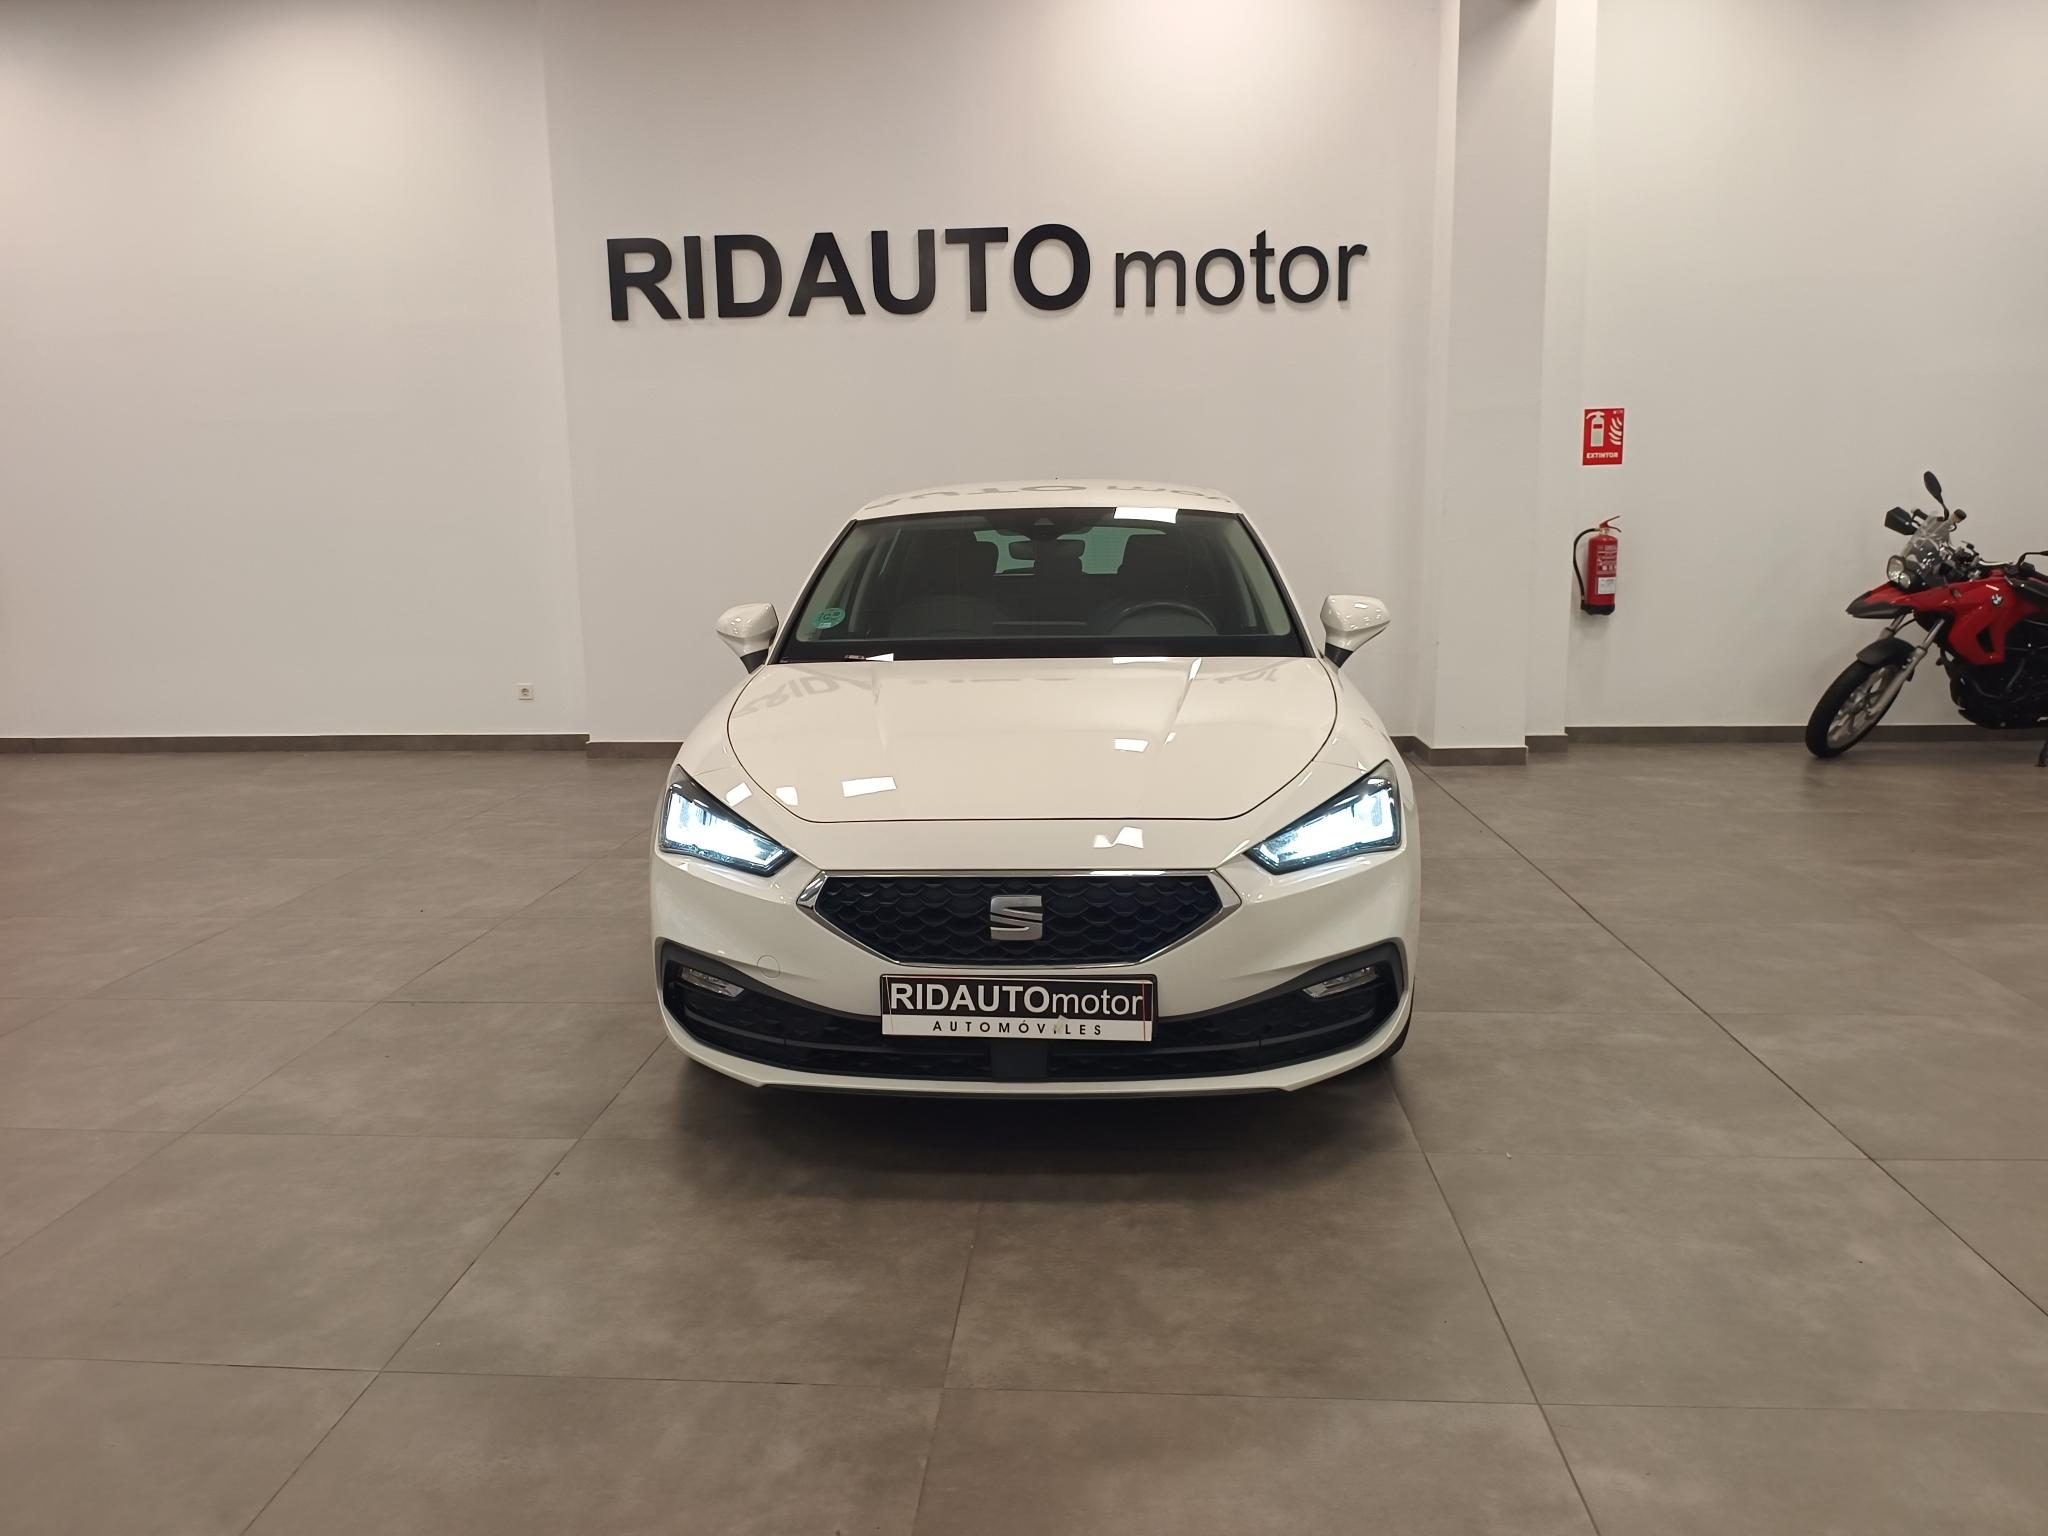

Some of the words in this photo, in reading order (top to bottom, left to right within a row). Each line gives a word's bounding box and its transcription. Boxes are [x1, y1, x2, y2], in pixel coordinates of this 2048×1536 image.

[606, 223, 1091, 322] RIDAUTO
[1115, 229, 1368, 309] motor
[890, 983, 1144, 1015] RIDAUTOmotor
